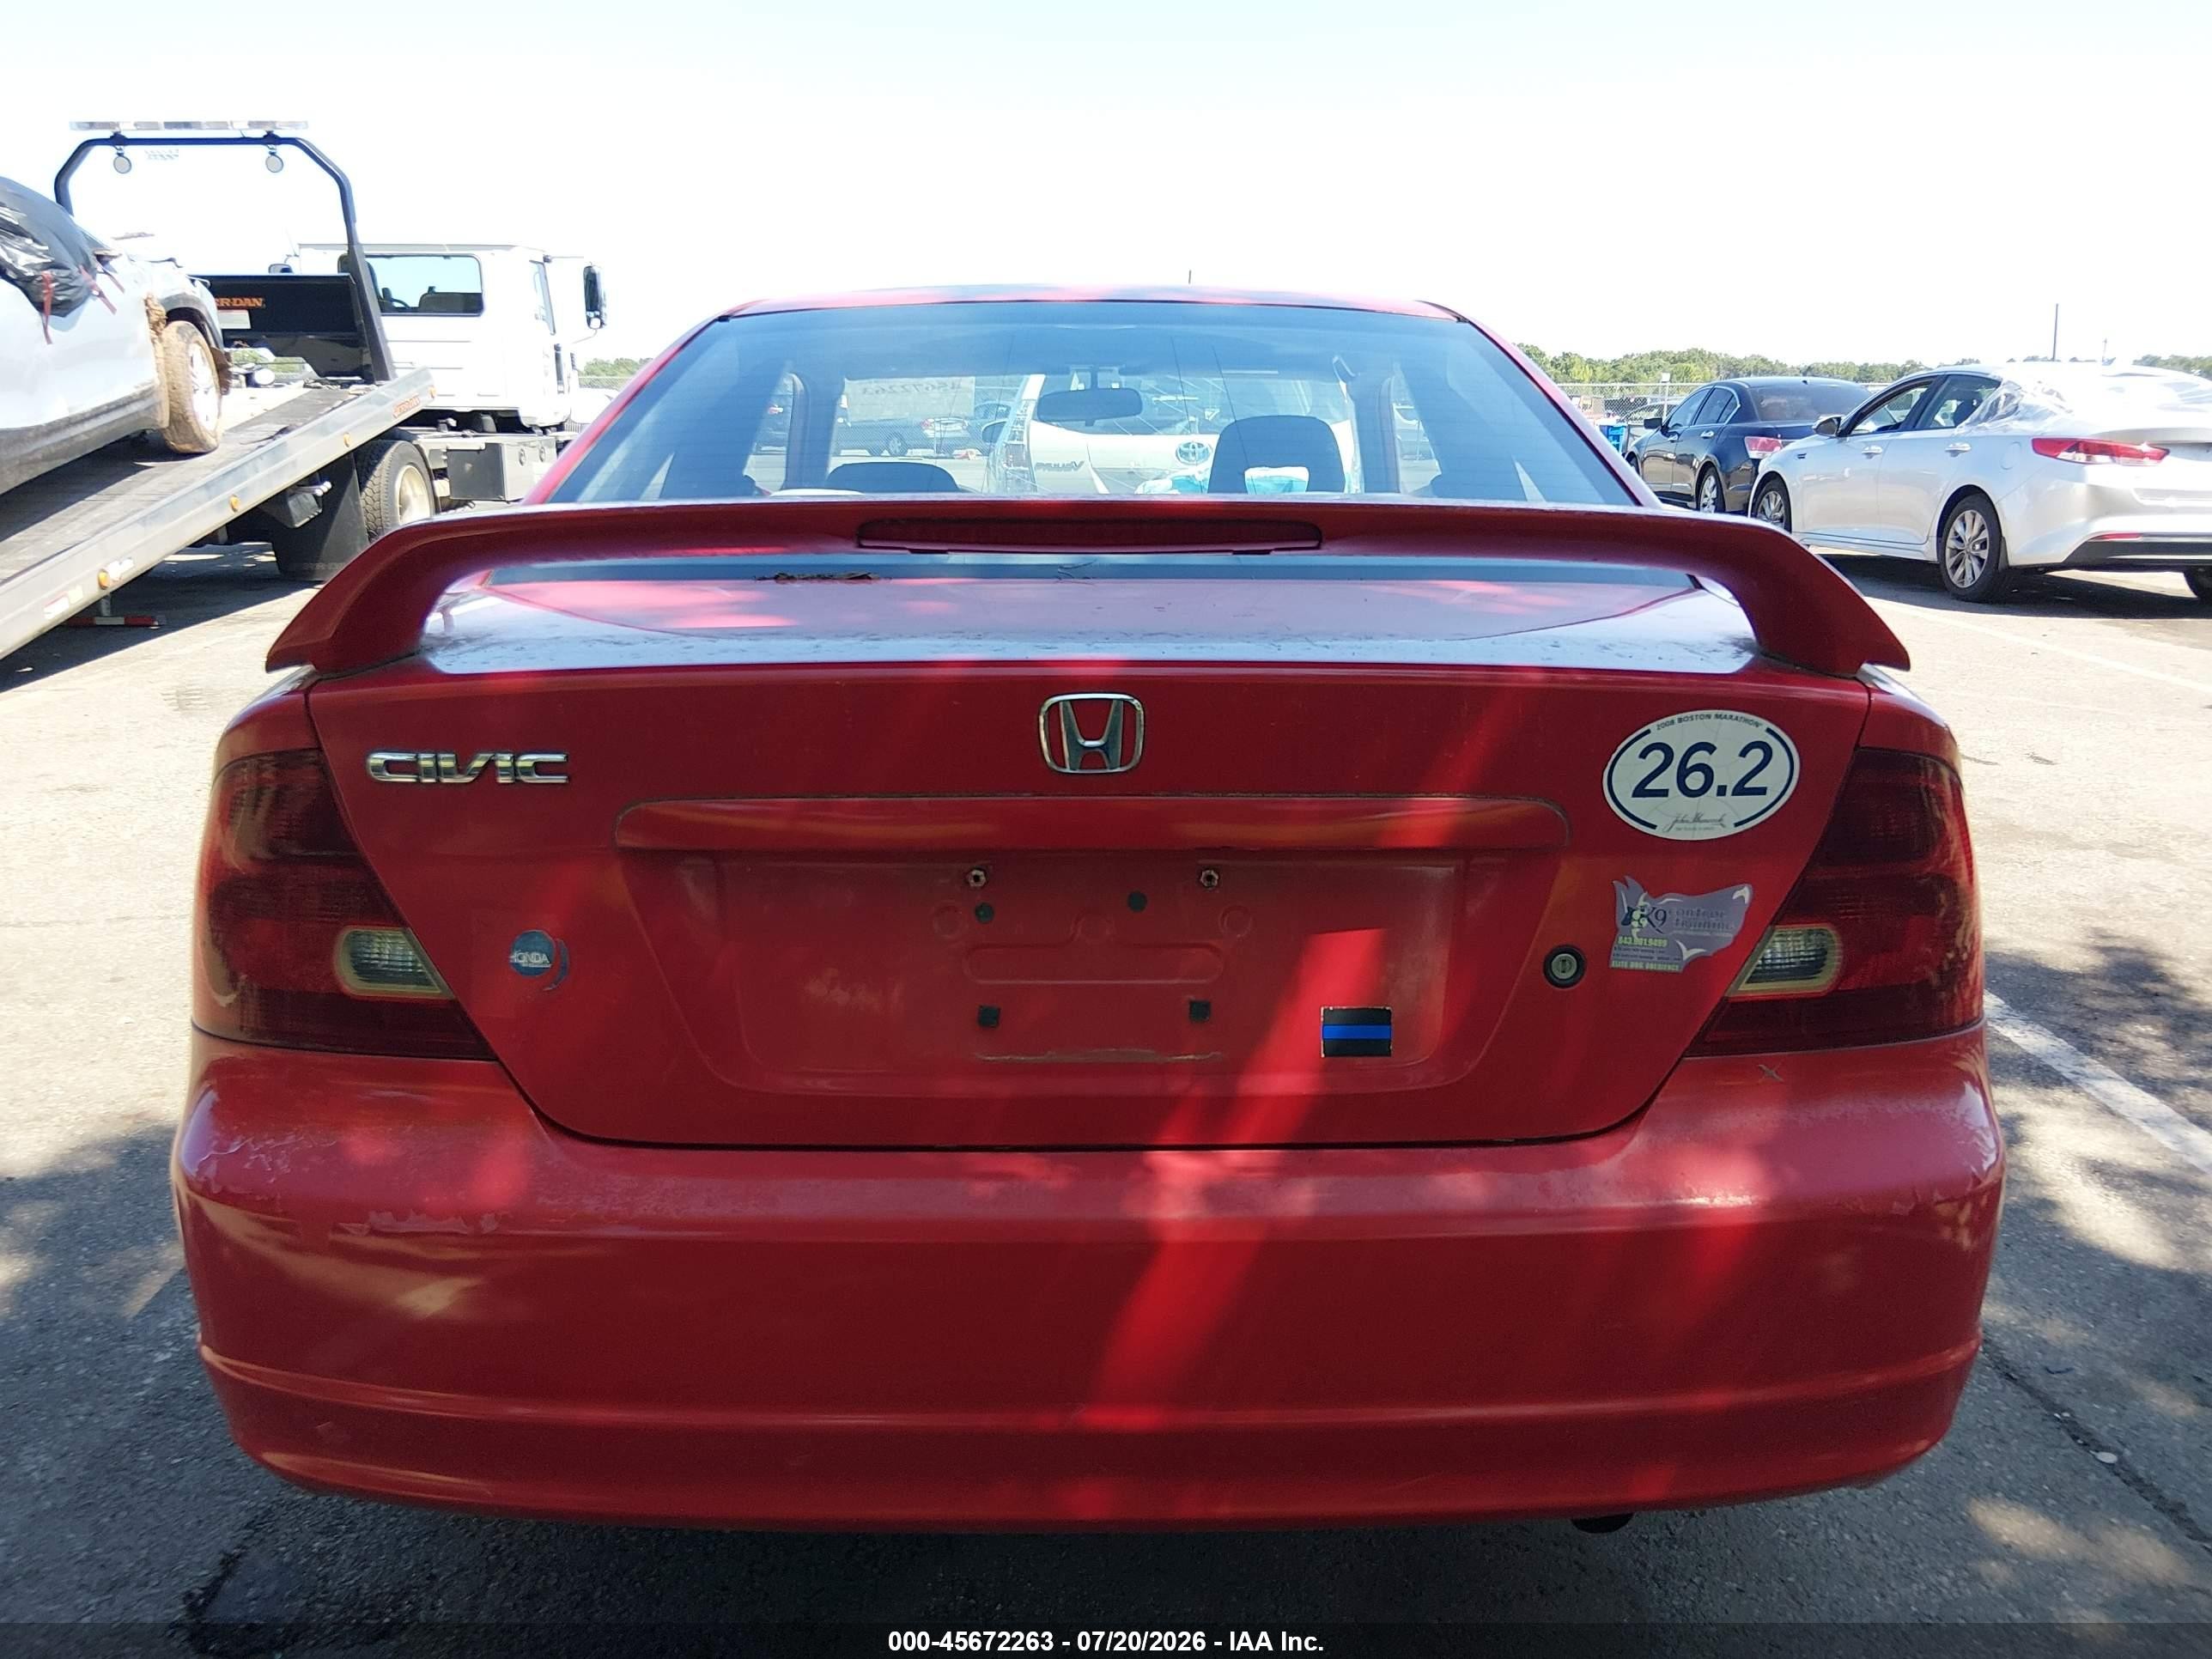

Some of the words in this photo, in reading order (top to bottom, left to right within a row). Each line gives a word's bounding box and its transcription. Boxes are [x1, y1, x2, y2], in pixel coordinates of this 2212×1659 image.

[1677, 714, 1712, 724] BOSTON
[1714, 714, 1760, 728] MARATHON
[367, 750, 568, 783] CIVIC
[1632, 740, 1773, 799] 26.2
